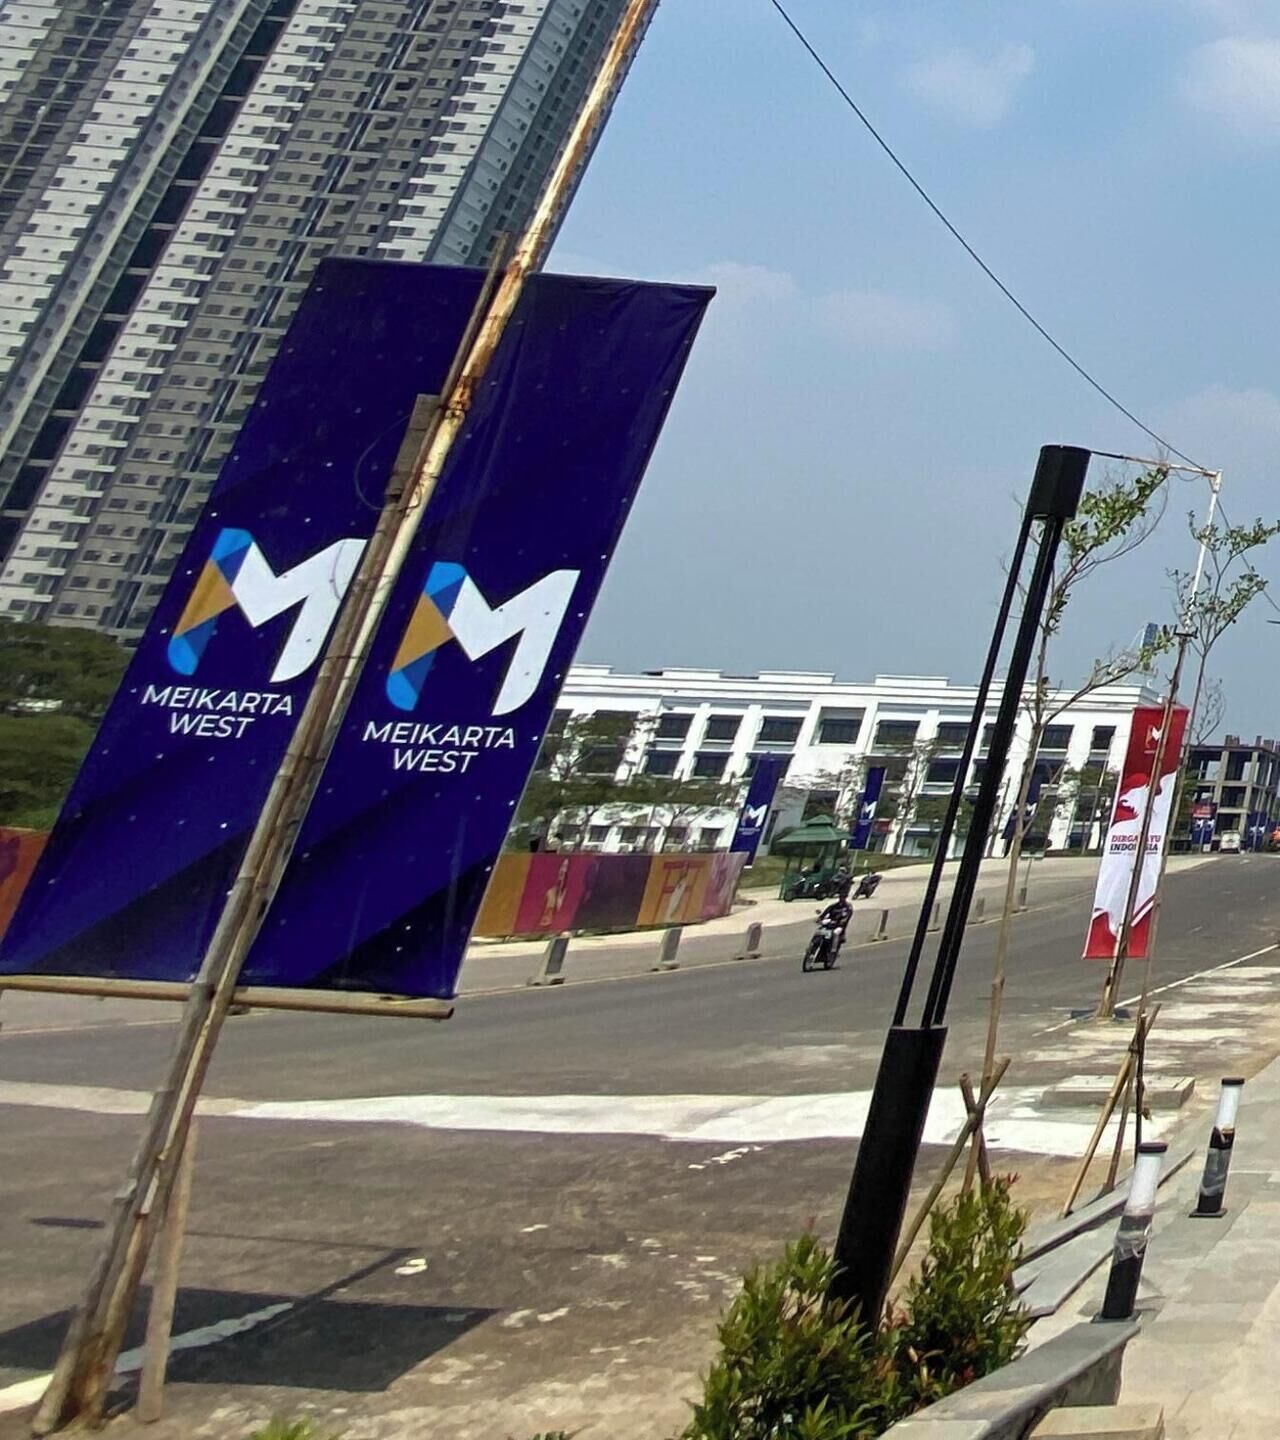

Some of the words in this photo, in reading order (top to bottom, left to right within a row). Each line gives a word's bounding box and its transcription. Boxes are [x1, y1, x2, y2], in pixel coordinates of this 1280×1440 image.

[141, 685, 293, 716] MEIKARTA
[169, 713, 255, 739] WEST
[362, 721, 515, 749] MEIKARTA
[393, 748, 479, 773] WEST
[1111, 834, 1161, 843] DIRGAYU
